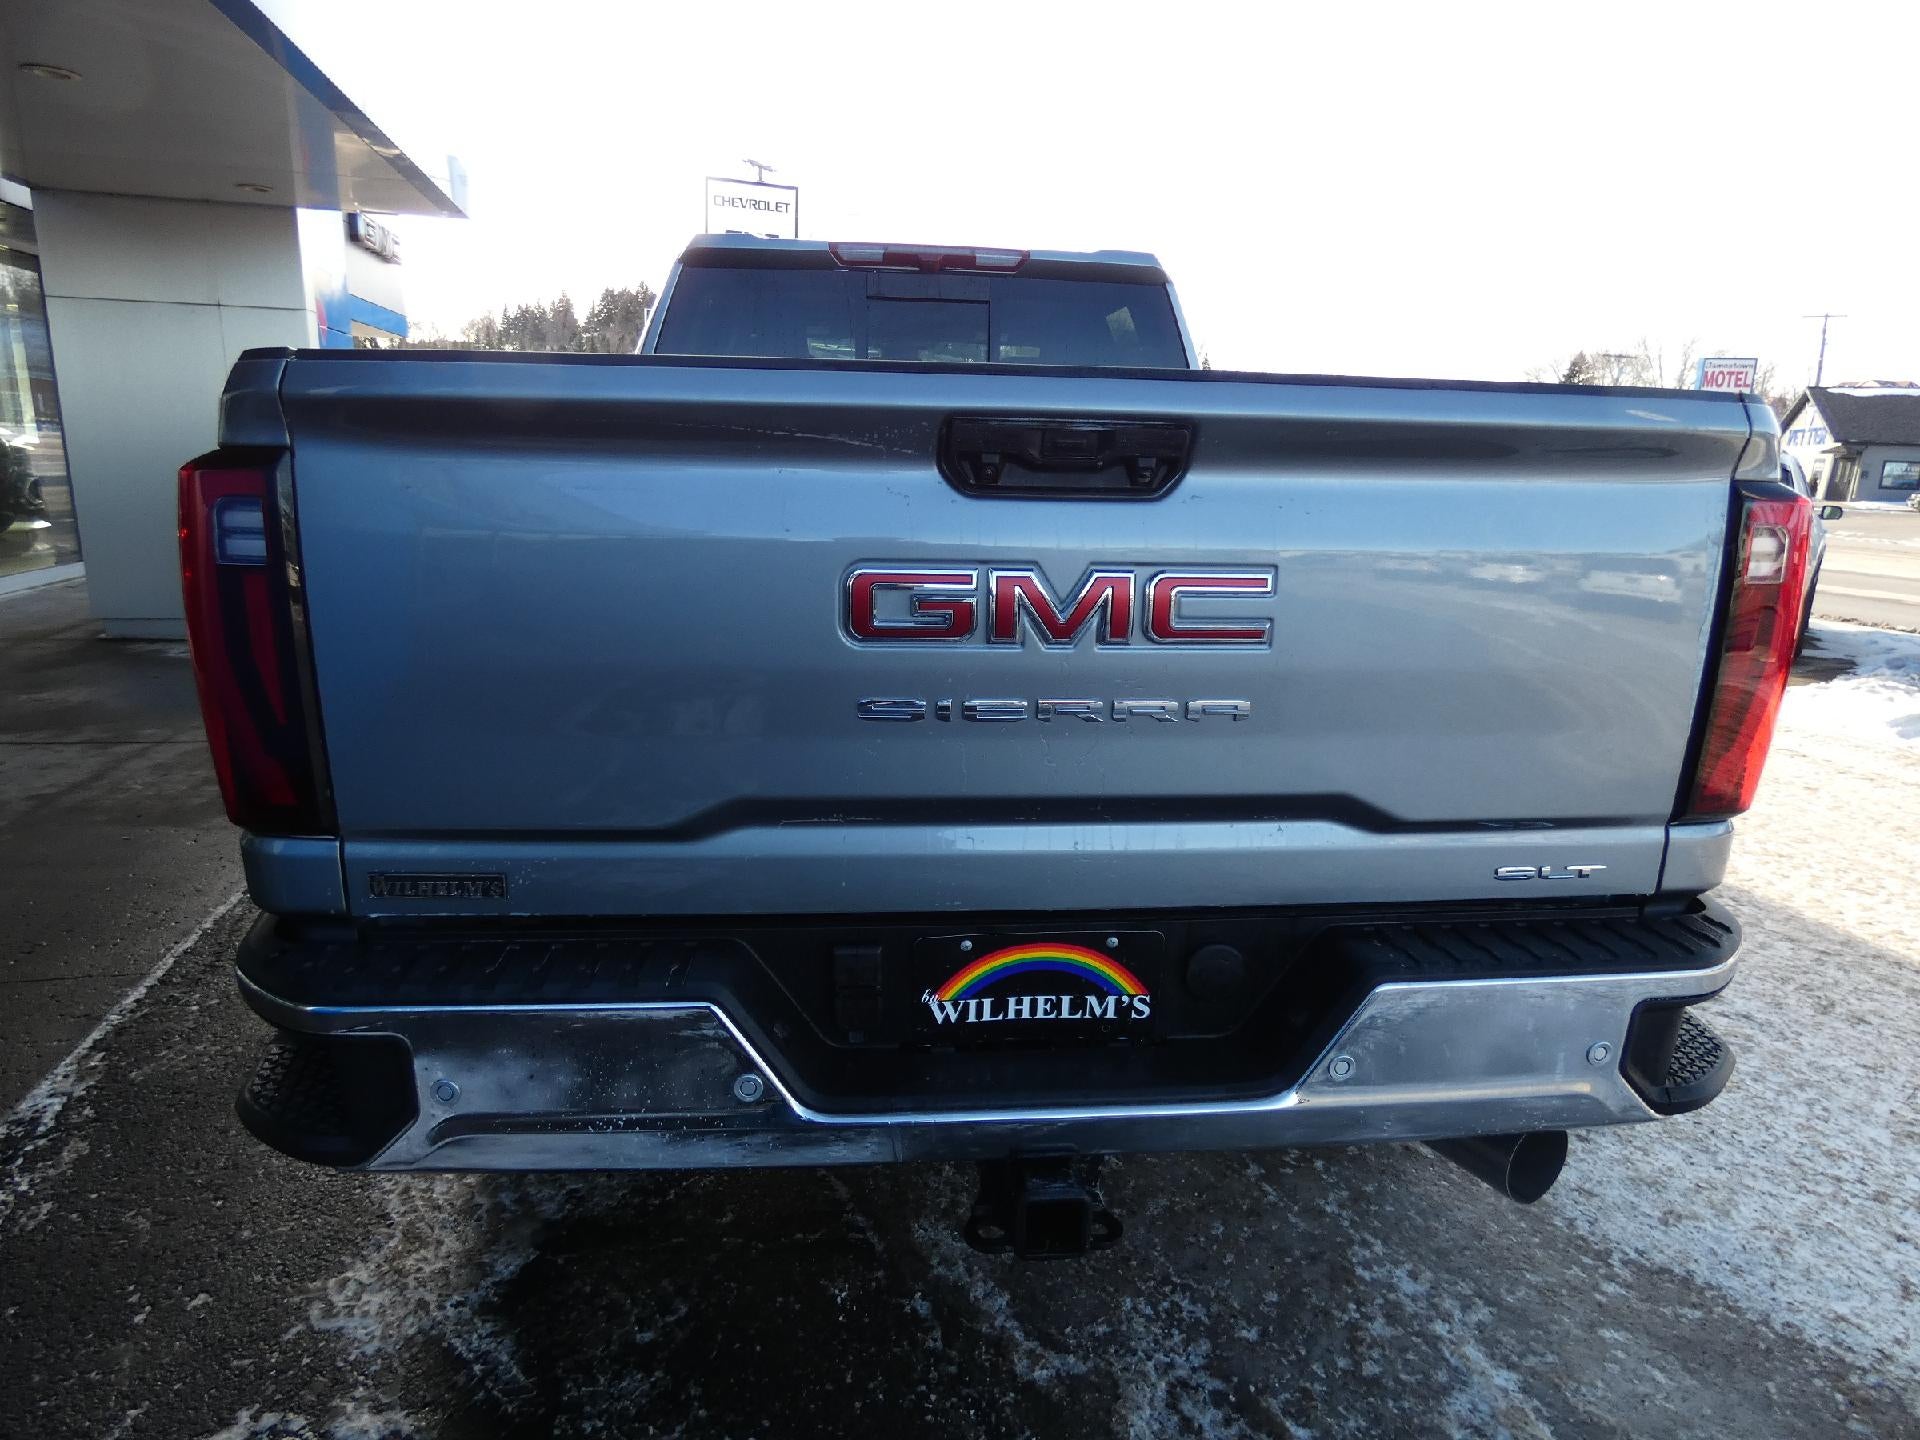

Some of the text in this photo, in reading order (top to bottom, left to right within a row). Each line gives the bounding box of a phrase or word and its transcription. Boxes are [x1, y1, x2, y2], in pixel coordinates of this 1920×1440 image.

[713, 194, 791, 214] CHEVROLET
[1702, 370, 1751, 388] MOTEL
[848, 567, 1274, 643] GMC
[857, 699, 1251, 723] SIERRA
[1494, 864, 1607, 880] SLT
[929, 994, 1151, 1025] WILHELM'S
